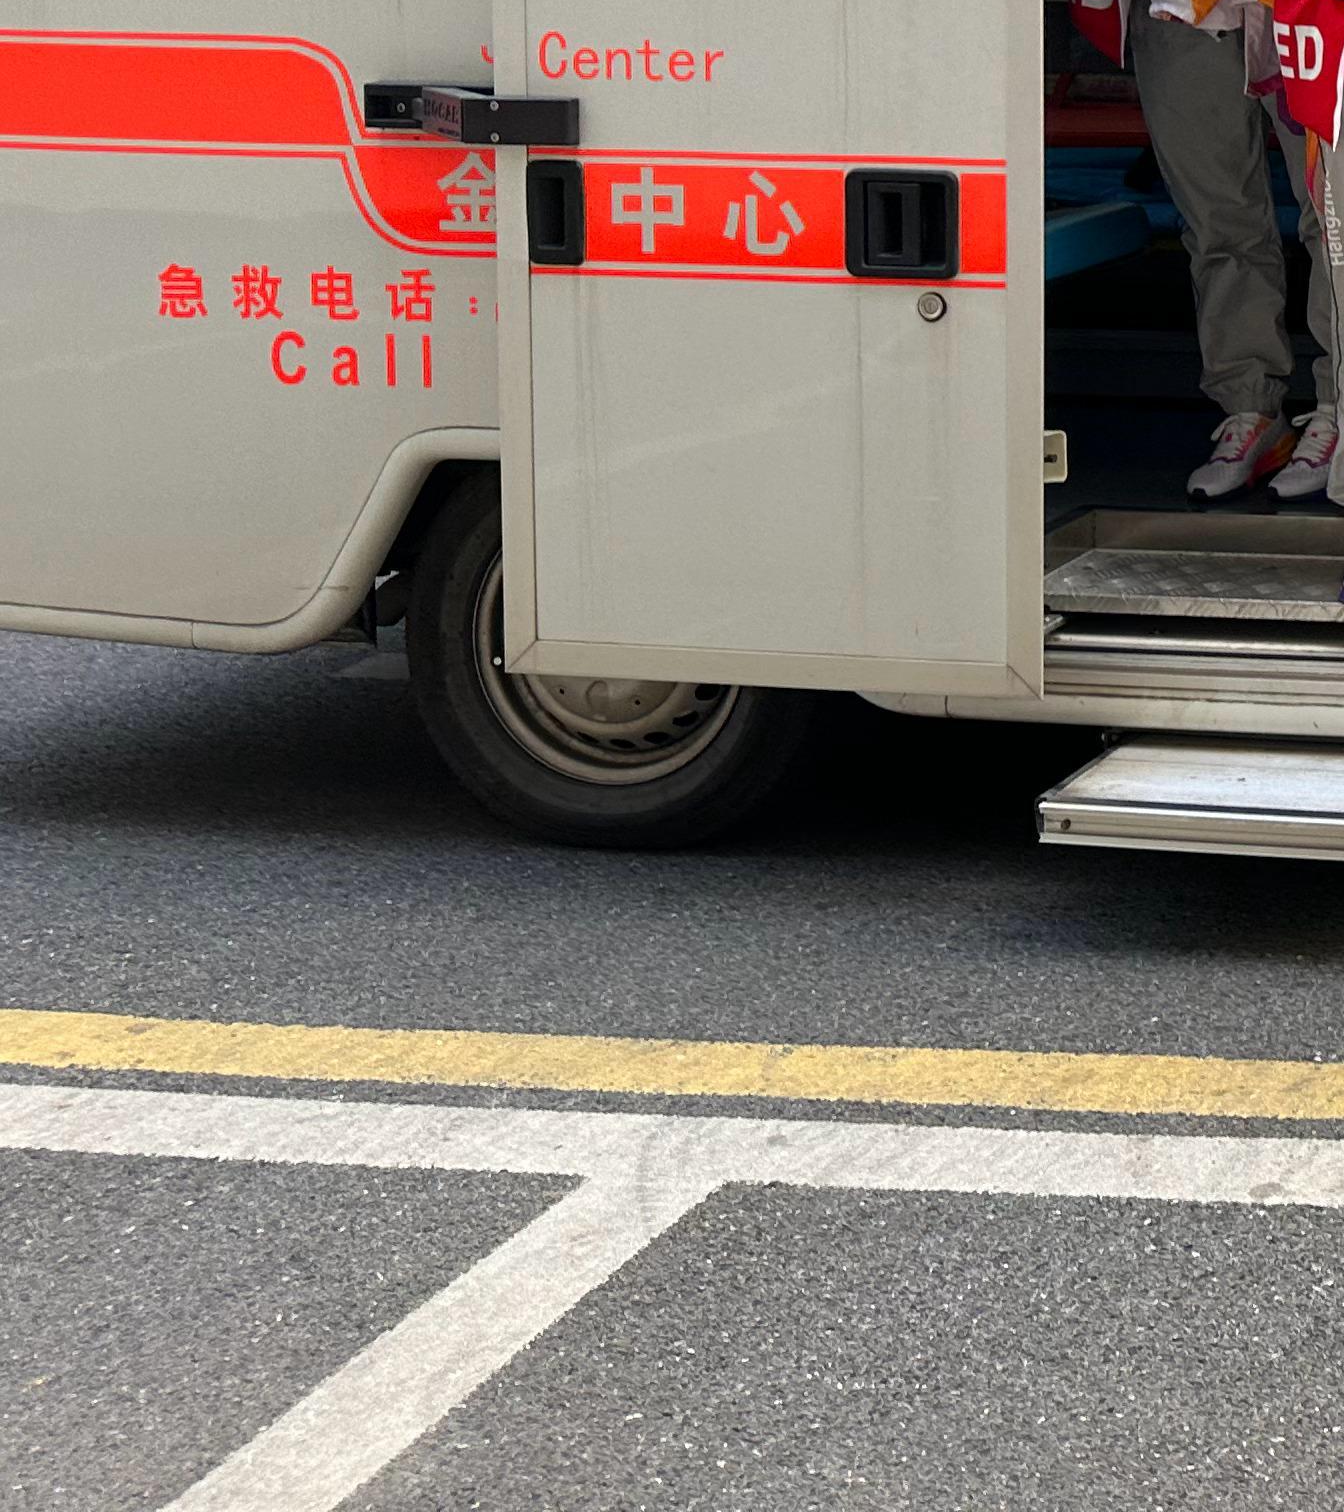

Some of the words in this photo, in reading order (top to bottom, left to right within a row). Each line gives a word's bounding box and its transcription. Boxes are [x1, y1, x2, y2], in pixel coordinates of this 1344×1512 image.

[538, 30, 725, 82] Center
[610, 166, 805, 256] 中心
[271, 330, 433, 389] Call
